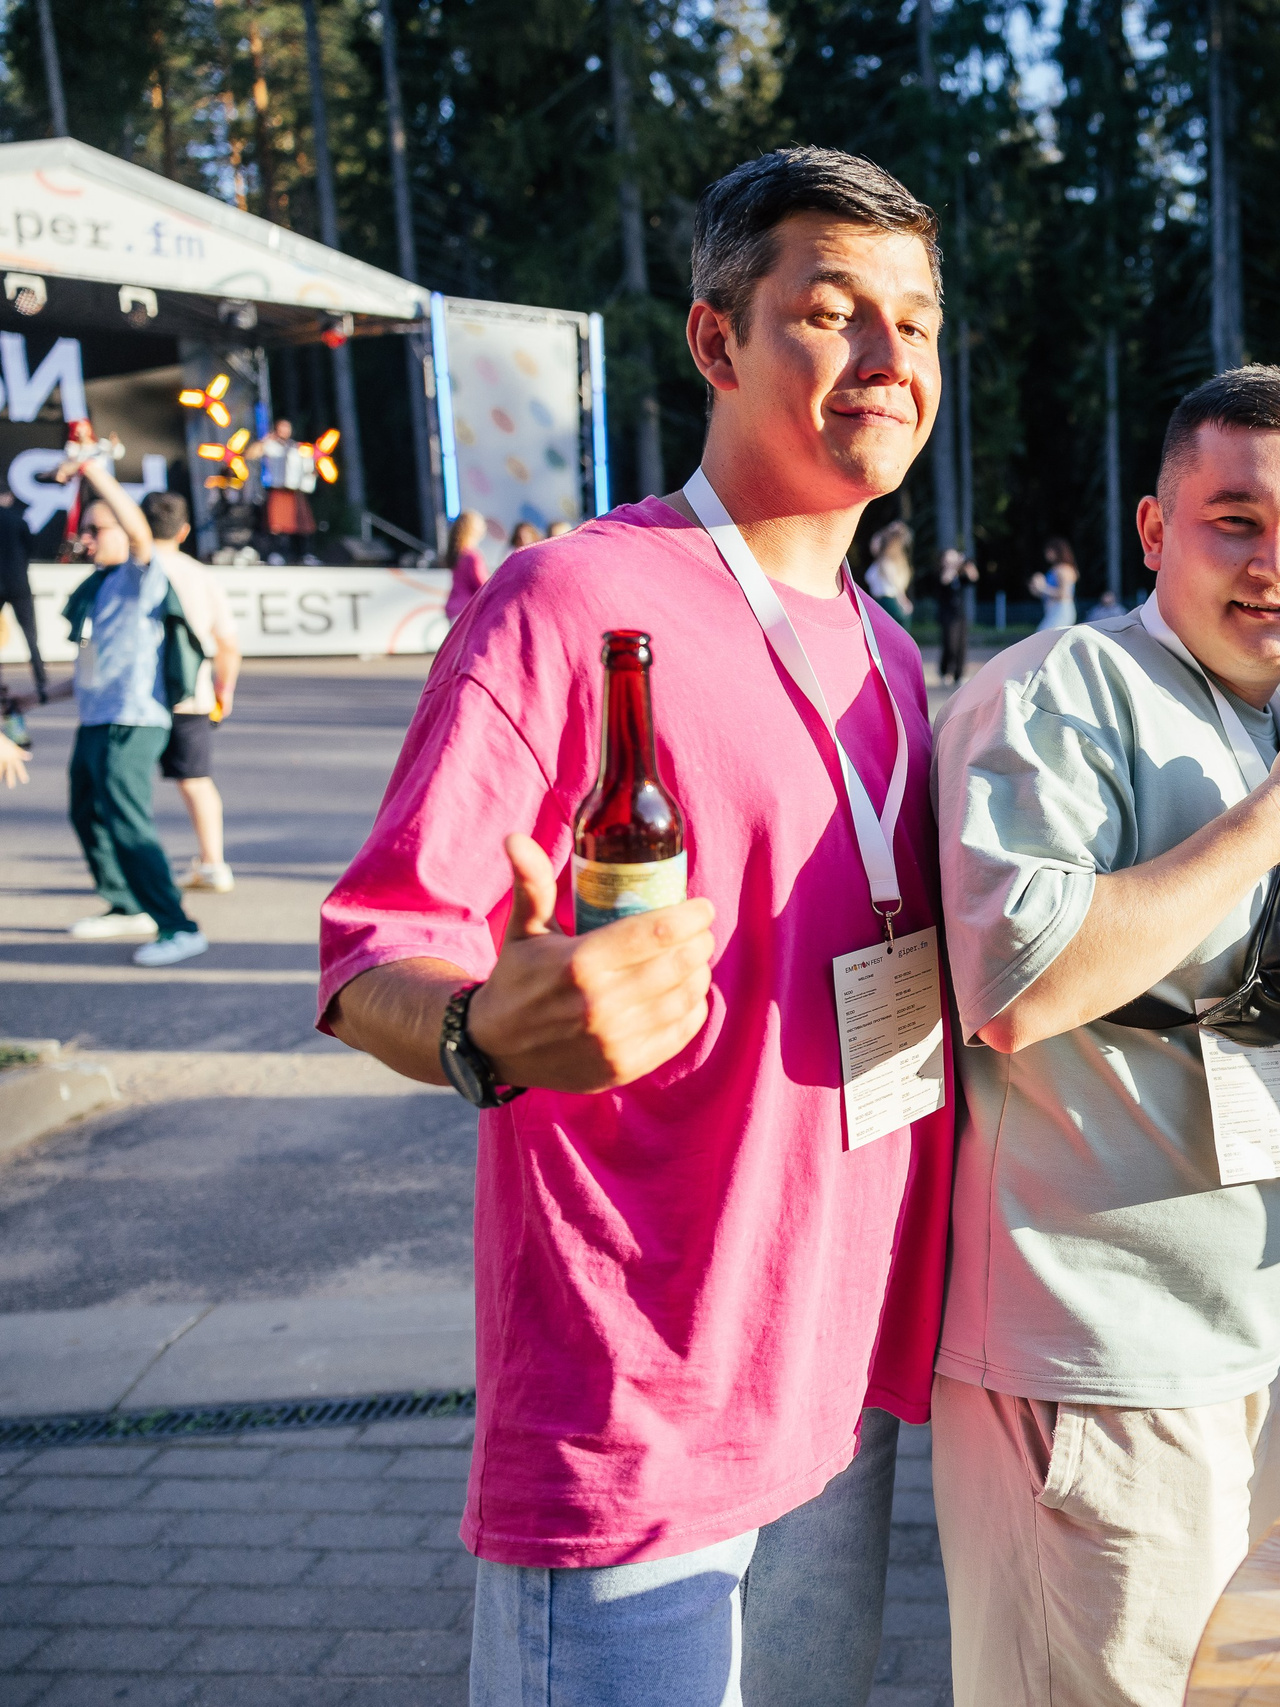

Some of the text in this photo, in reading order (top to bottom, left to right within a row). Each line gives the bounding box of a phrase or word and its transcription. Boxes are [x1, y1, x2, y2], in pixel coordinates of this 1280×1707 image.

[0, 206, 206, 259] per.fm
[897, 940, 929, 959] giper.fm
[870, 956, 884, 966] FEST
